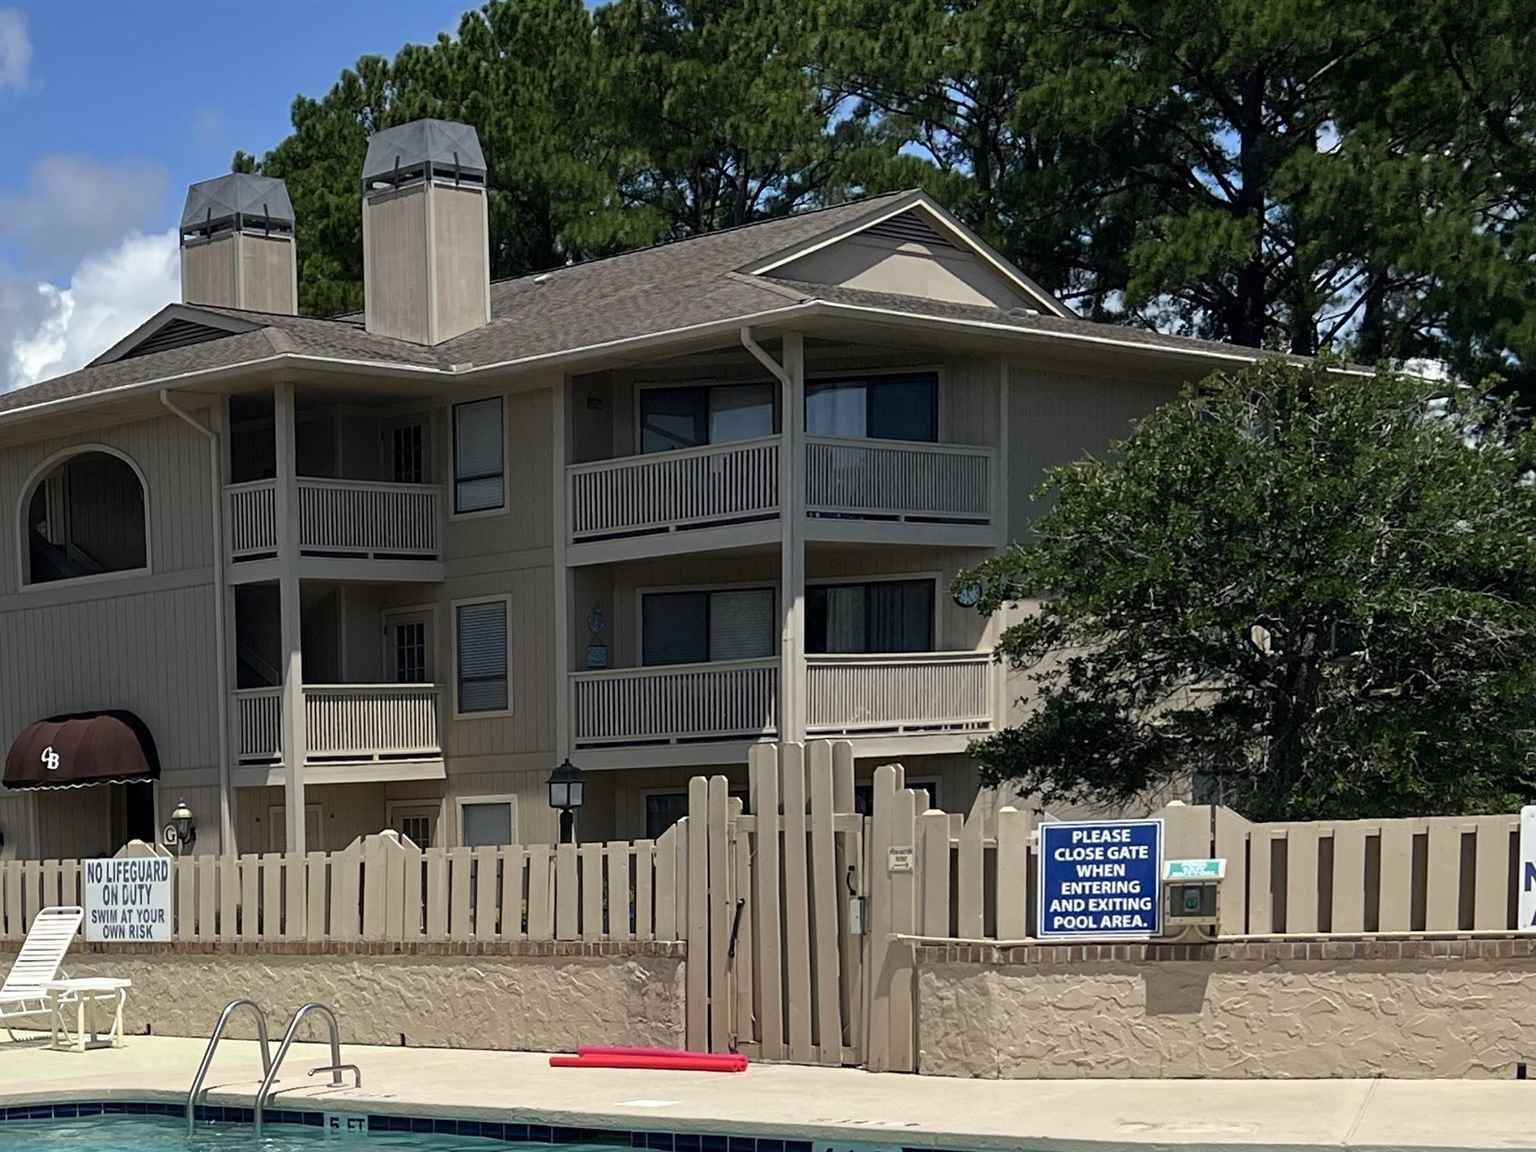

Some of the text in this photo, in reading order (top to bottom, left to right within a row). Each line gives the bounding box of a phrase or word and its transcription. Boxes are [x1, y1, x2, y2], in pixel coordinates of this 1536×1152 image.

[165, 827, 176, 843] G
[1072, 829, 1131, 844] PLEASE
[1054, 846, 1149, 861] CLOSE GATE
[87, 860, 168, 883] NO LIFEGUARD
[1076, 864, 1125, 878] WHEN
[102, 884, 152, 906] ON DUTY
[1061, 880, 1141, 895] ENTERING
[1049, 897, 1152, 913] AND EXITING
[91, 908, 165, 924] SWIM AT YOUR
[1053, 915, 1148, 929] POOL AREA.
[102, 924, 153, 939] OWN RISK
